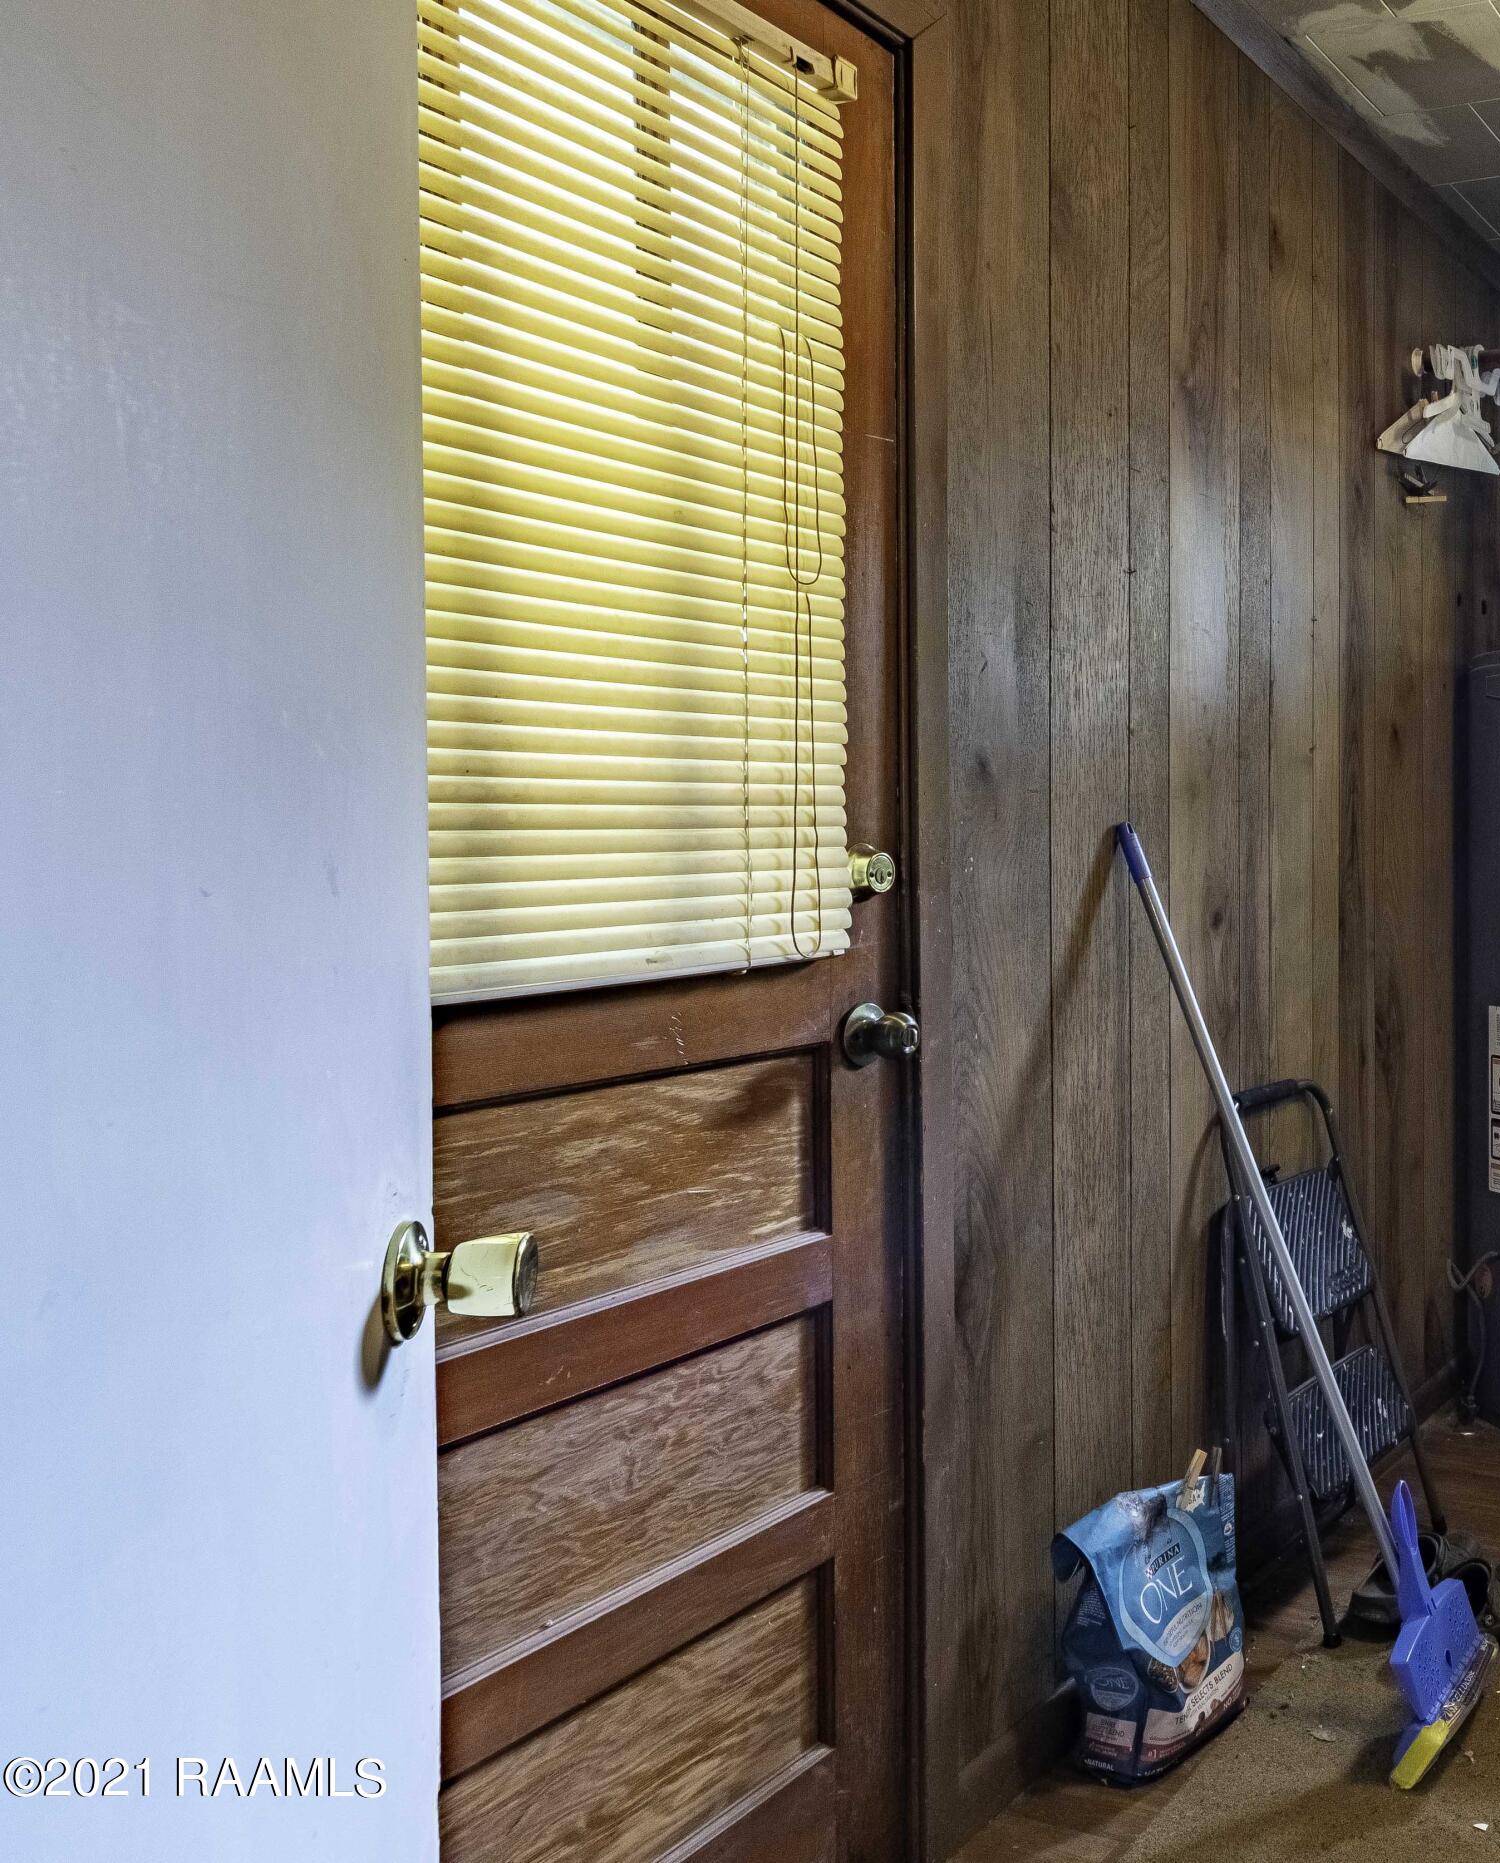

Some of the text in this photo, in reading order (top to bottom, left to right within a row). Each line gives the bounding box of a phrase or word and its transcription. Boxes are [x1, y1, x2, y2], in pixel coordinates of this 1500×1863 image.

[1150, 1545, 1180, 1573] PURINA
[1140, 1555, 1193, 1624] ONE
[1190, 1681, 1214, 1708] SELECTS
[1213, 1663, 1233, 1685] BLEND
[1086, 1758, 1115, 1772] NATURAL
